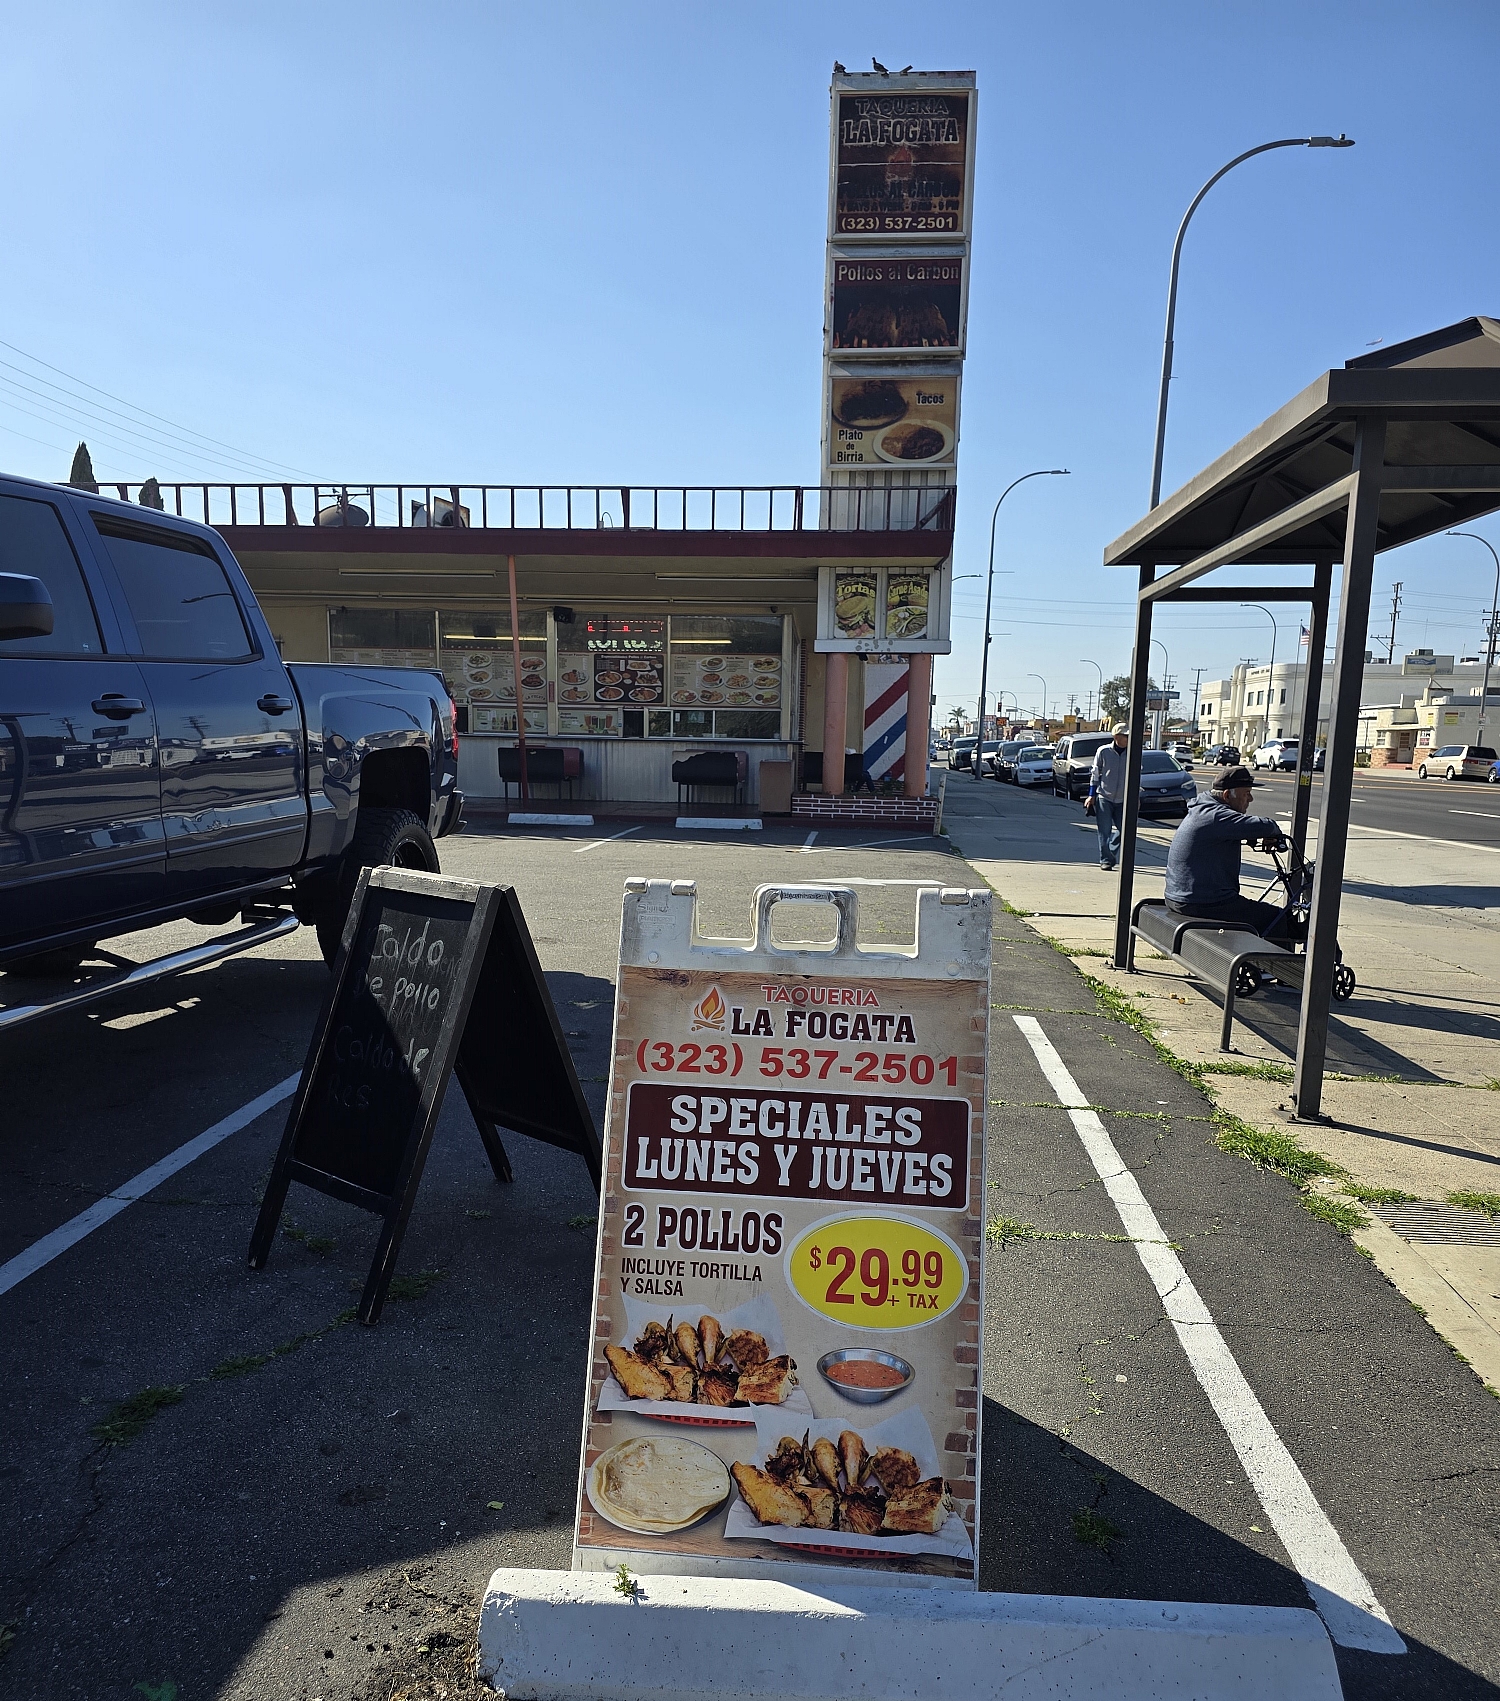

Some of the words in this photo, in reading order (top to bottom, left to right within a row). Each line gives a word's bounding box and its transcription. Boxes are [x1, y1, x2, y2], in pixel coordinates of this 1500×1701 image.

[855, 98, 949, 118] TAQUERIA
[844, 119, 872, 145] LA
[878, 118, 960, 145] FOGATA
[841, 217, 880, 230] (323)
[885, 216, 953, 229] 537-2501
[838, 264, 883, 281] Pollos
[906, 263, 960, 281] Carbon
[916, 392, 945, 405] Tacos
[838, 430, 863, 441] Plato
[837, 451, 864, 462] Birria
[846, 442, 855, 451] de
[837, 583, 876, 598] Tortas
[761, 985, 880, 1008] TAQUERIA
[730, 1008, 774, 1037] LA
[786, 1010, 916, 1043] FOGATA
[636, 1038, 744, 1077] (323)
[759, 1047, 958, 1087] 537-2501
[670, 1095, 922, 1146] SPECIALES
[635, 1136, 760, 1185] LUNES
[773, 1143, 798, 1187] Y
[808, 1146, 953, 1197] JUEVES
[623, 1204, 645, 1246] 2
[656, 1206, 784, 1255] POLLOS
[621, 1257, 686, 1277] INCLUYE
[689, 1260, 763, 1281] TORTILLA
[809, 1245, 944, 1306] $29.99
[620, 1277, 633, 1293] Y
[635, 1278, 684, 1296] SALSA
[907, 1293, 939, 1310] TAX
